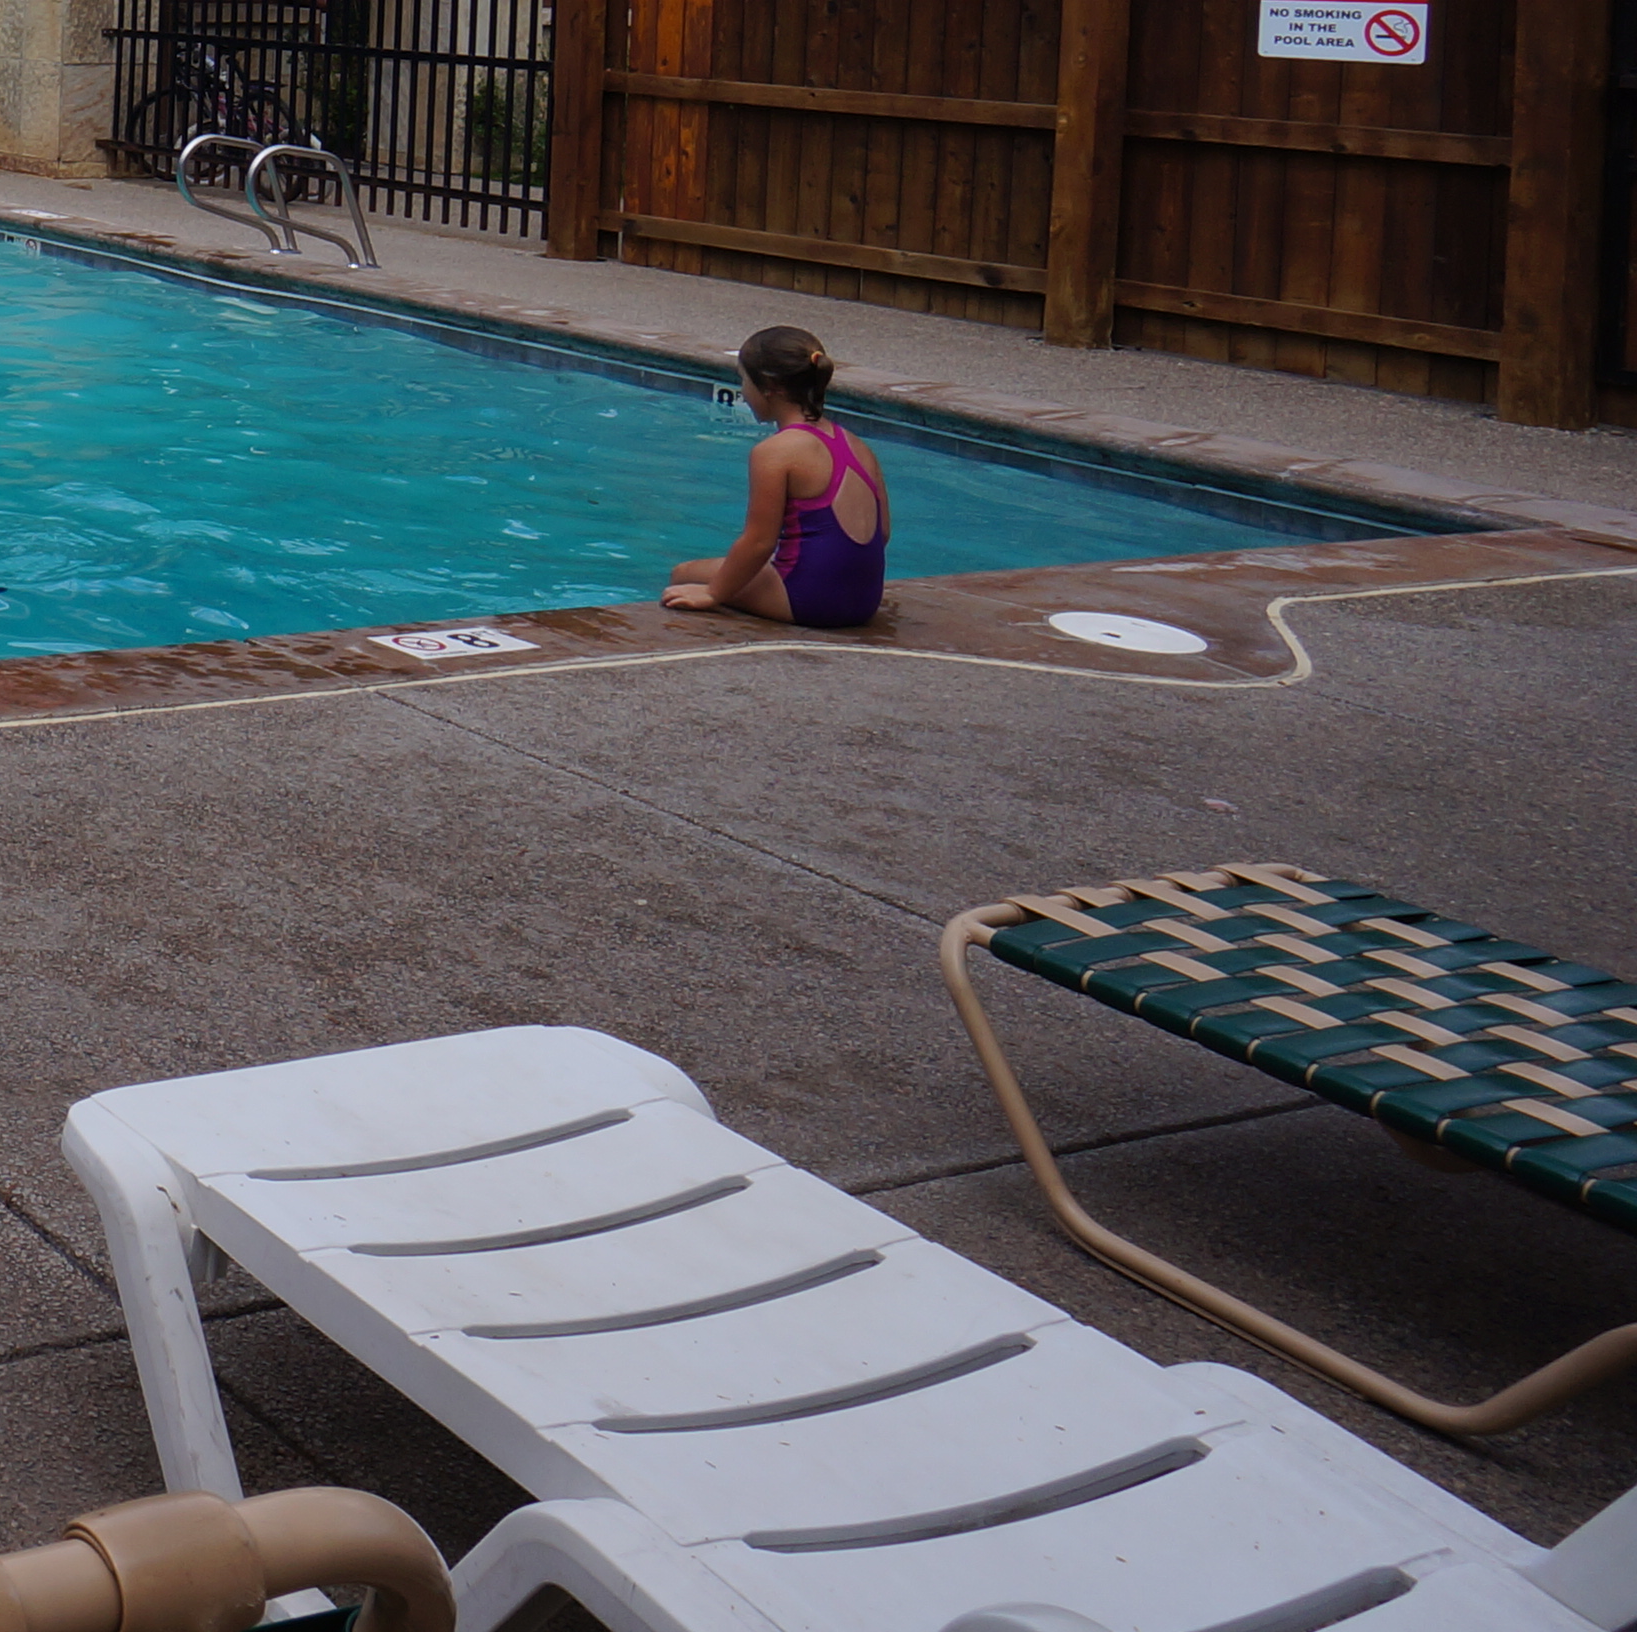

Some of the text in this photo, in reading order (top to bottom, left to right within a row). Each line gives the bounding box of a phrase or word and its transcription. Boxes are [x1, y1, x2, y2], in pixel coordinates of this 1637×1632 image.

[1269, 8, 1362, 20] NO SMOKING
[1289, 22, 1337, 33] IN THE
[1274, 35, 1355, 48] POOL AREA
[446, 633, 501, 649] 8
